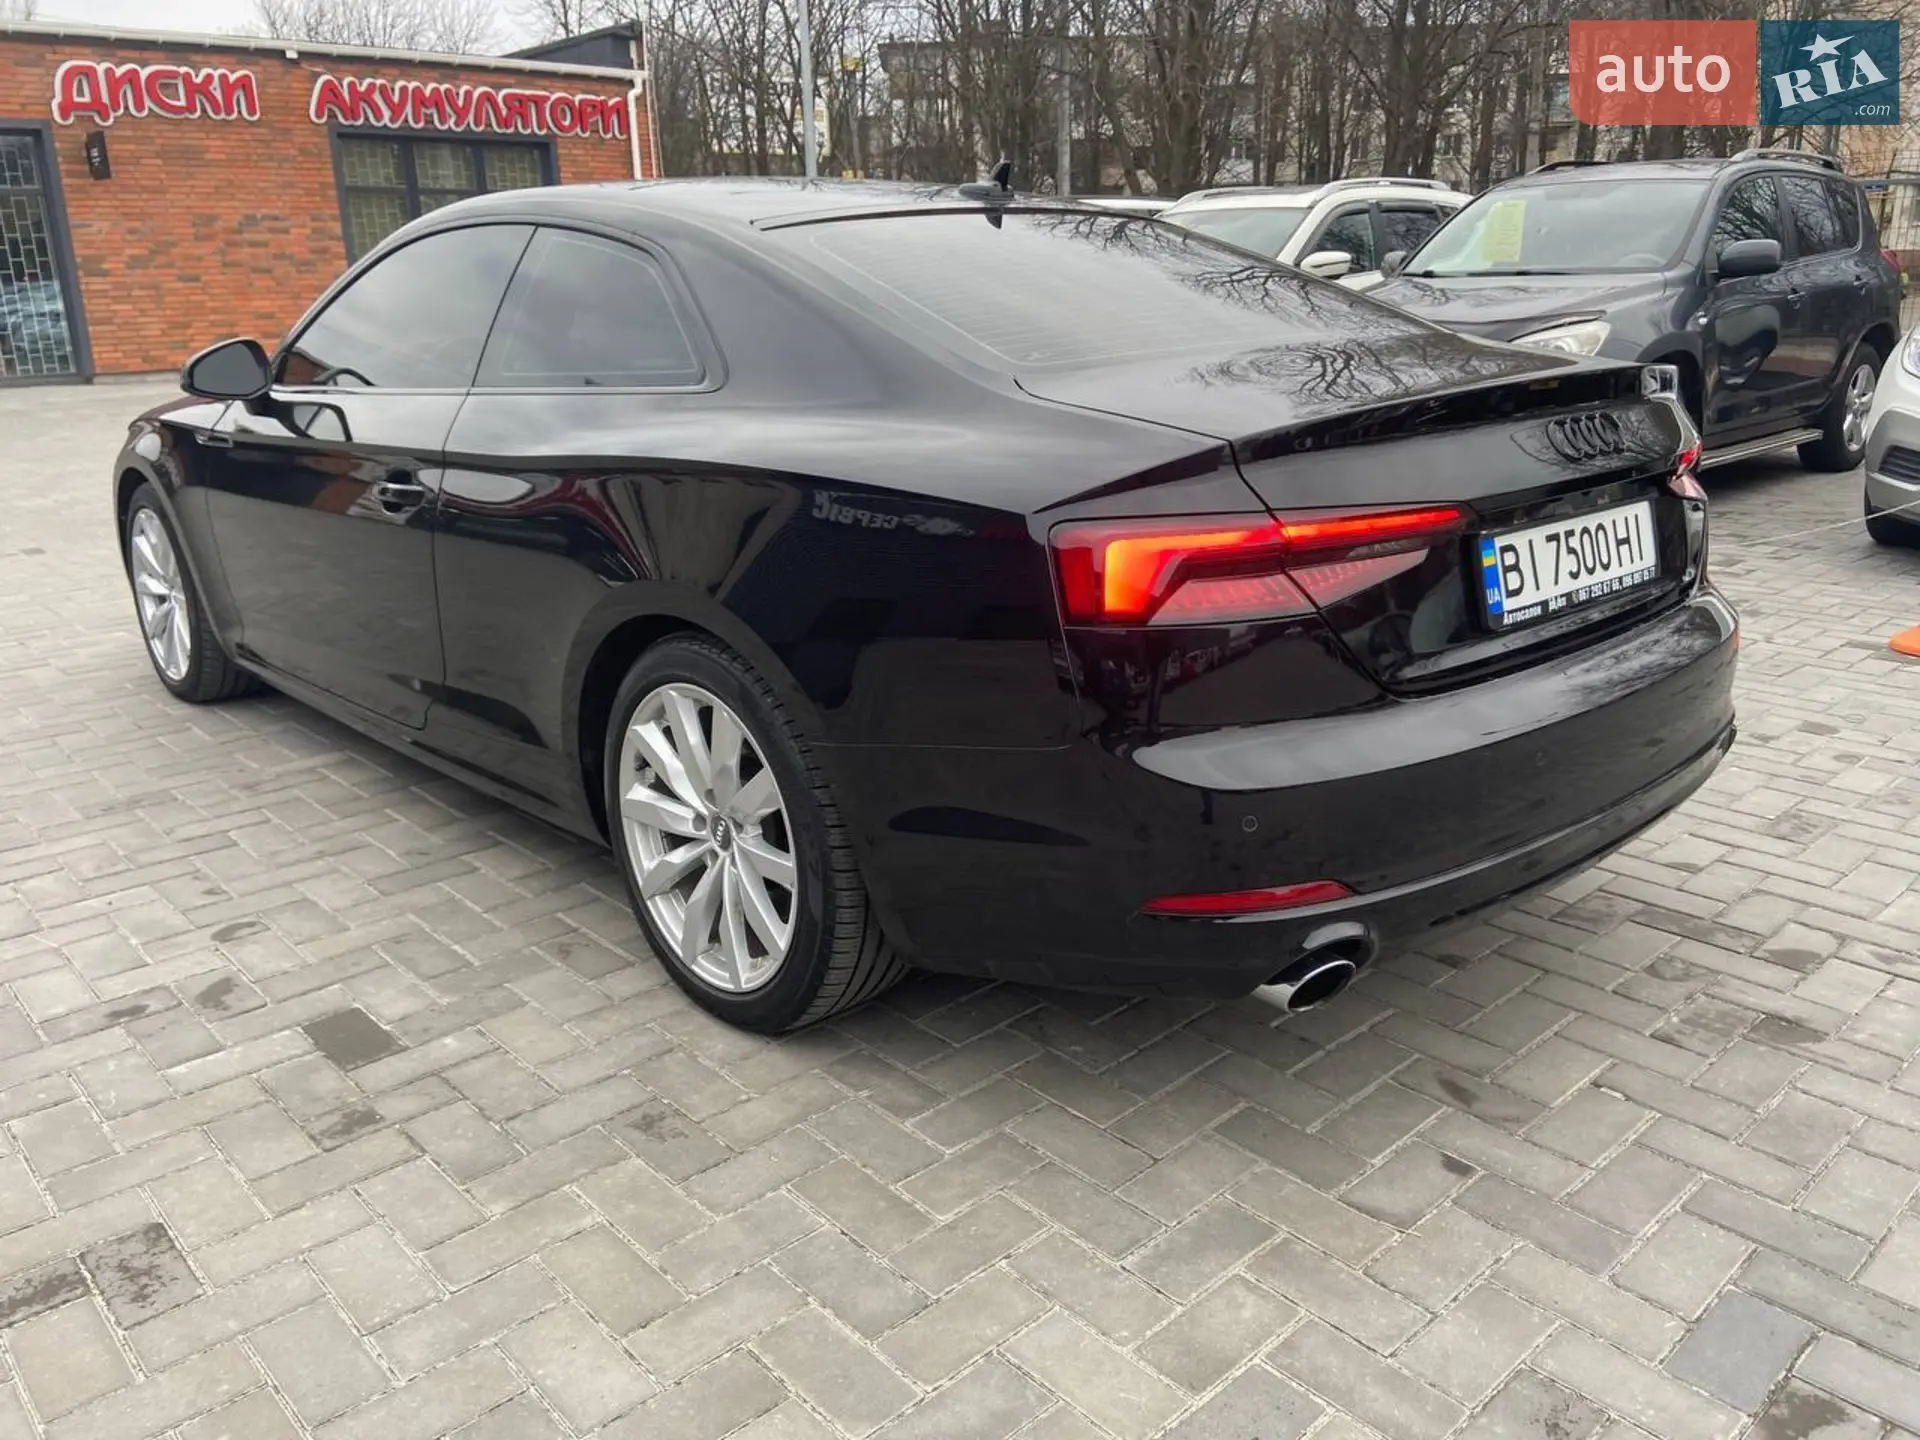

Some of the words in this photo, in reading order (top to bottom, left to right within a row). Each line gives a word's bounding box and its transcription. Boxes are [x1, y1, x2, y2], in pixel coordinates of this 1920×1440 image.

[53, 61, 260, 126] ДИСКИ
[310, 74, 630, 139] АКУМУЛЯТОРИ
[1545, 522, 1611, 585] 7500
[1487, 588, 1500, 603] UA
